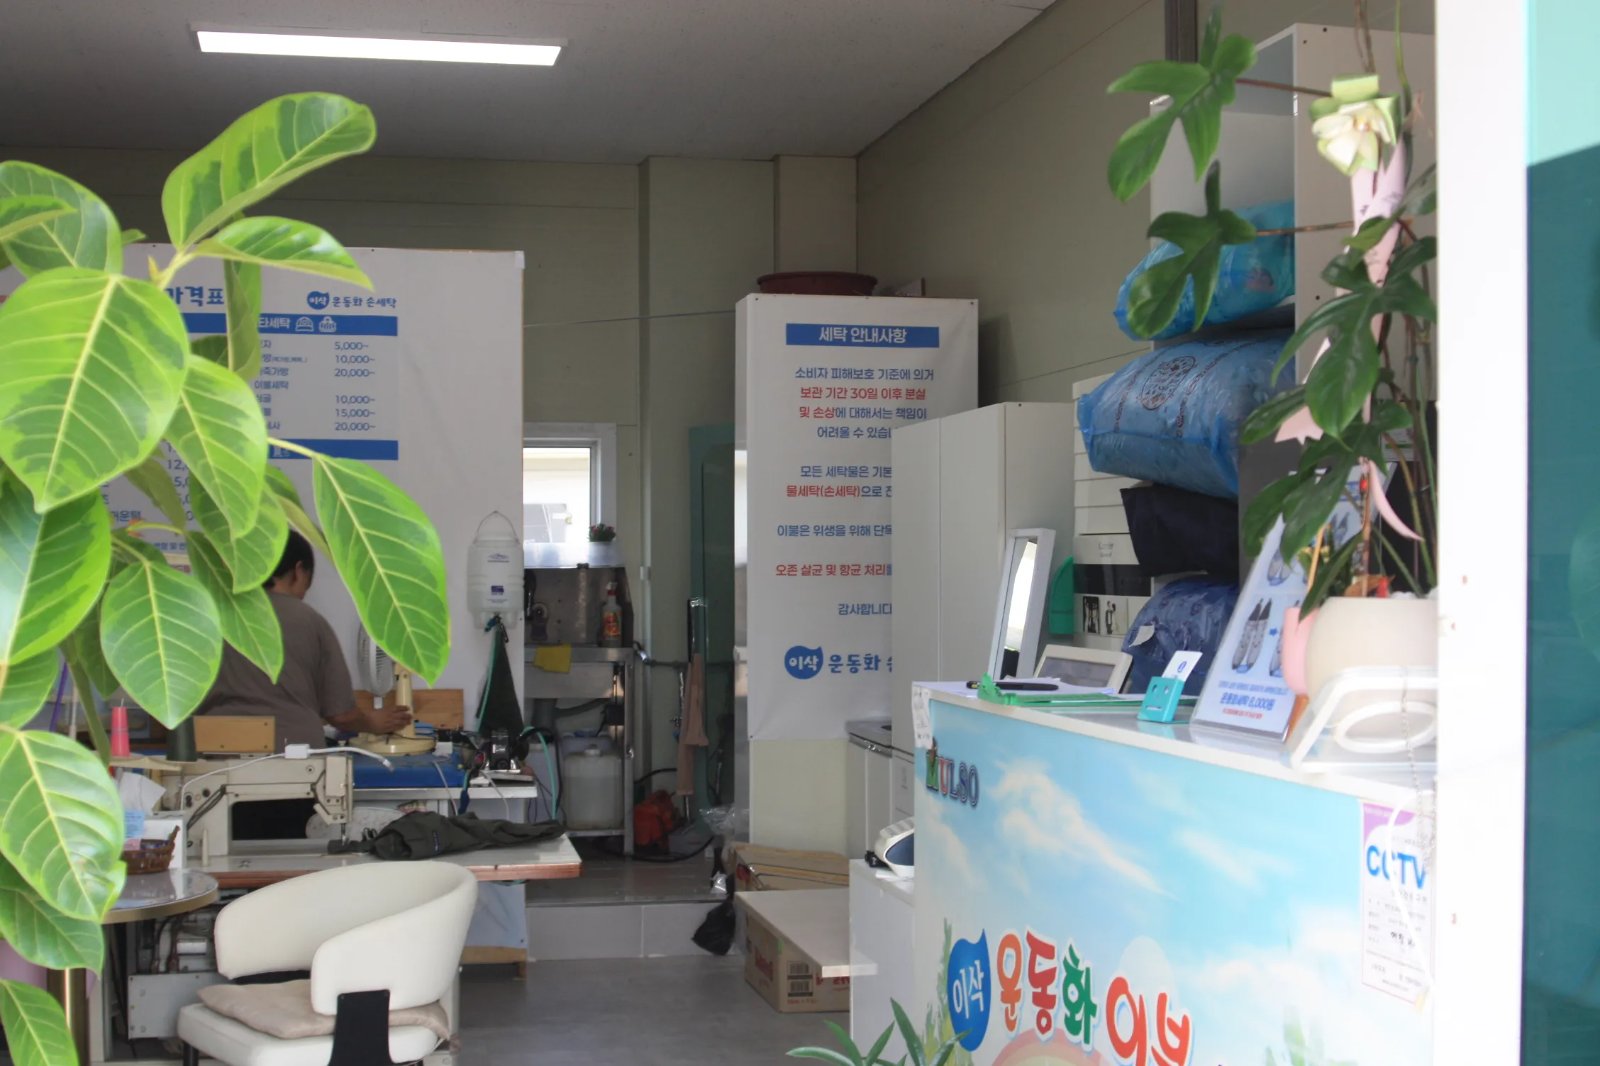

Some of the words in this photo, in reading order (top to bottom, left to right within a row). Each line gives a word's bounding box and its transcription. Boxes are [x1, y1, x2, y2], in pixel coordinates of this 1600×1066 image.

[332, 296, 363, 308] 운동화
[366, 297, 397, 309] 손세탁
[819, 326, 848, 343] 세탁
[850, 327, 907, 344] 안내사항
[334, 341, 369, 351] 5,000~
[335, 354, 376, 364] 10,000~
[334, 368, 376, 378] 20,000~
[795, 367, 828, 379] 소비자
[830, 368, 875, 380] 피해보호
[878, 368, 911, 380] 기준에
[913, 369, 934, 381] 의거
[800, 387, 823, 399] 보관
[825, 387, 848, 399] 기간
[850, 388, 878, 400] 30일
[881, 388, 902, 400] 이후
[335, 395, 376, 405] 10,000~
[335, 408, 376, 418] 15,000~
[799, 406, 810, 419] 및
[813, 406, 846, 419] 손상에
[850, 407, 893, 420] 대해서는
[895, 408, 927, 420] 책임이
[334, 422, 377, 432] 20,000~
[817, 426, 850, 439] 어려울
[853, 427, 864, 439] 수
[867, 427, 892, 439] 있습
[800, 466, 822, 478] 모든
[826, 466, 869, 478] 세탁물은
[777, 525, 810, 537] 이불은
[813, 525, 846, 537] 위생을
[849, 525, 871, 537] 위해
[776, 564, 798, 576] 오존
[801, 564, 823, 576] 살균
[825, 564, 837, 576] 및
[840, 564, 861, 576] 항균
[788, 655, 819, 671] 이삭
[828, 653, 882, 674] 운동화
[953, 959, 986, 1020] 이삭
[996, 929, 1098, 1045] 운동화
